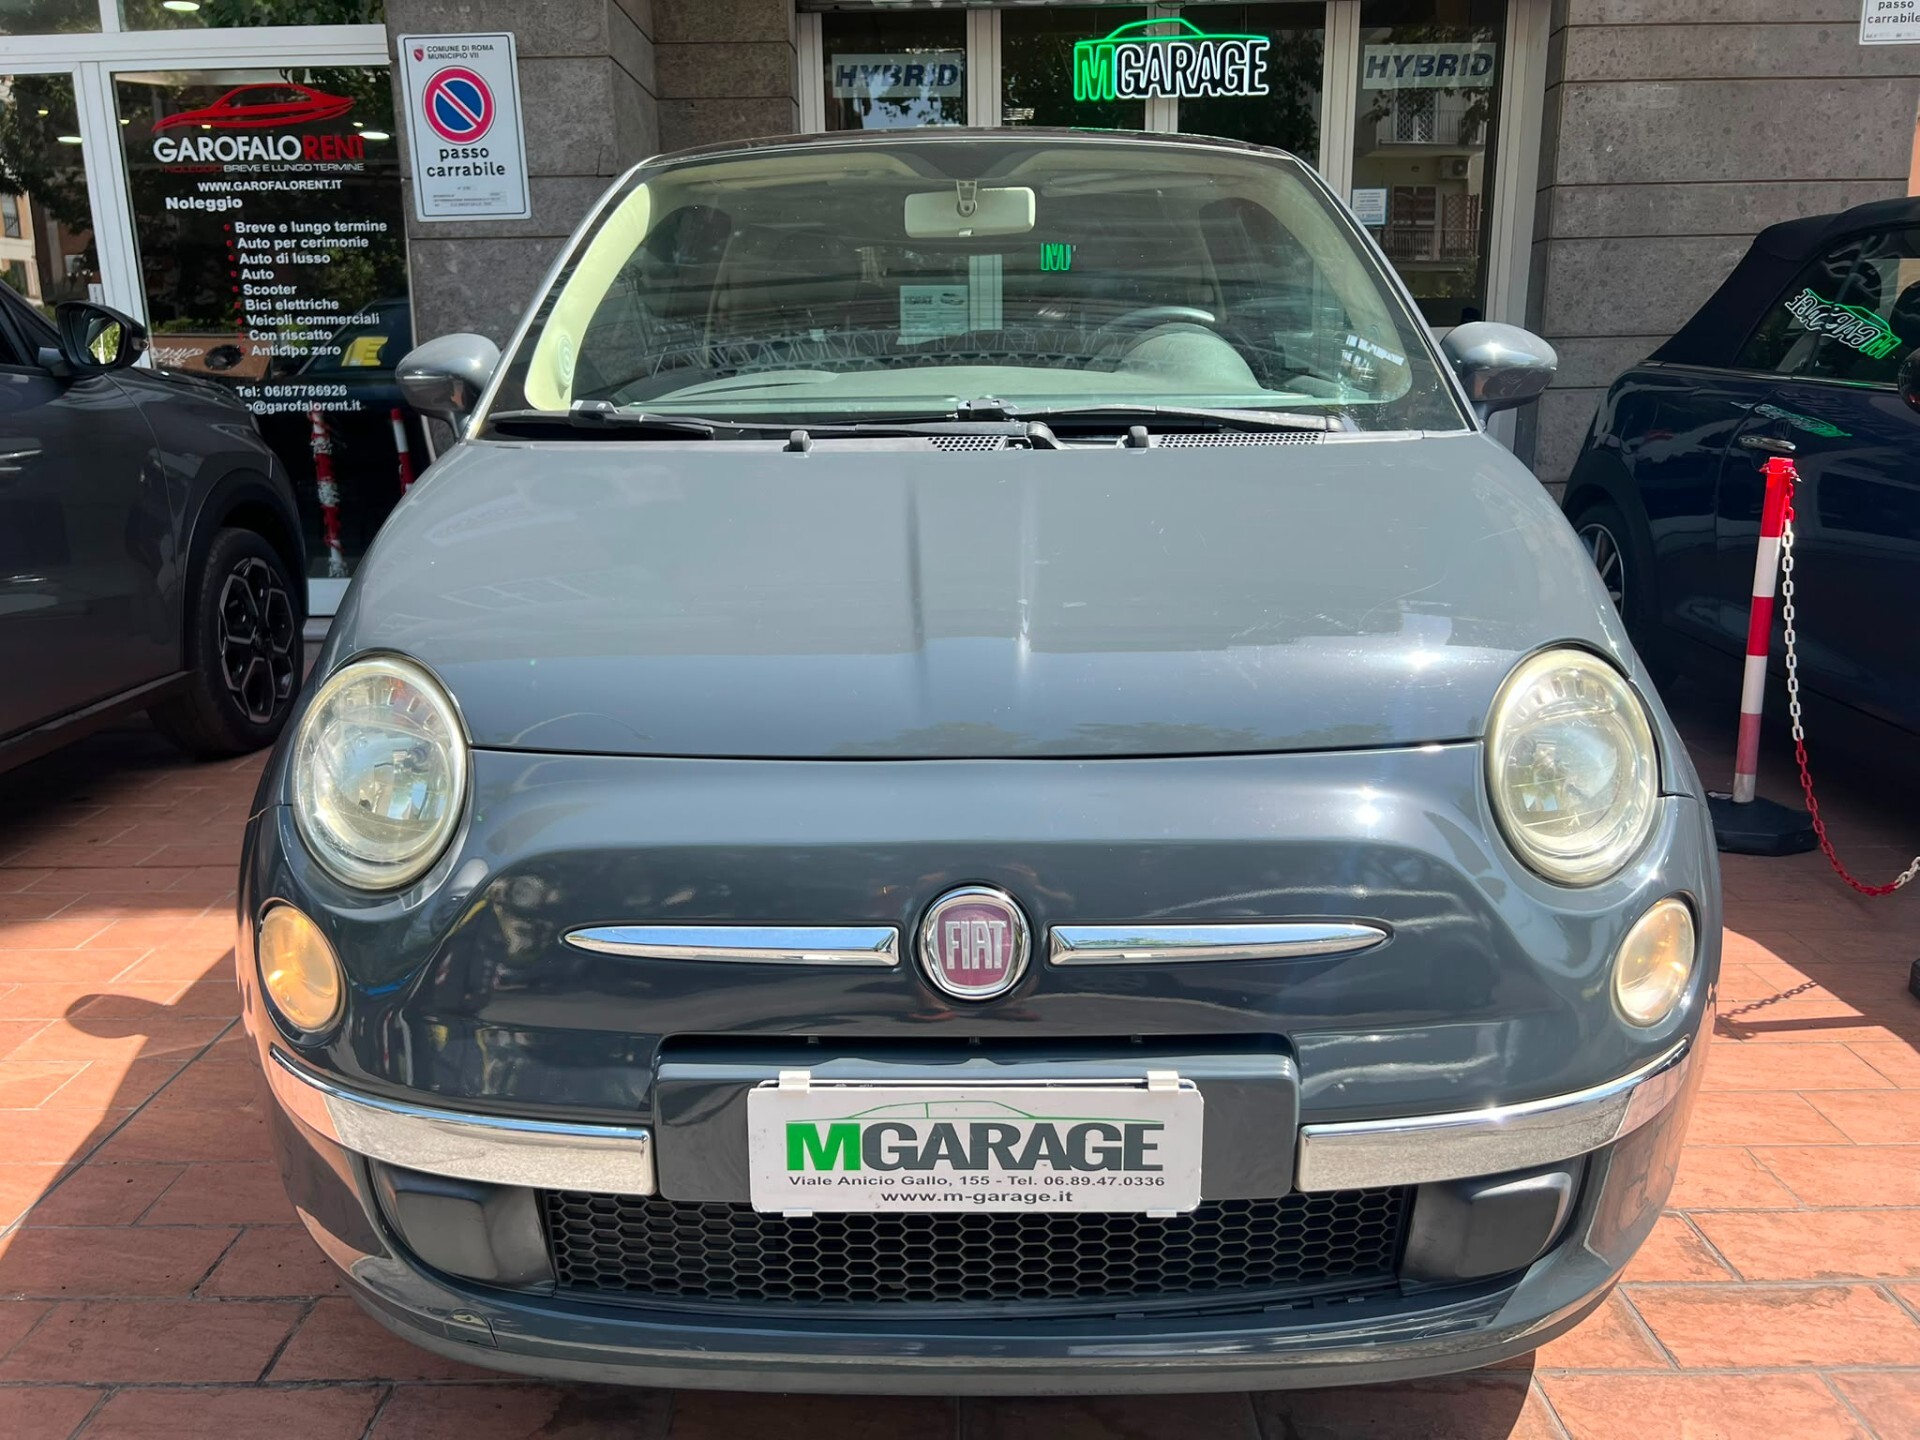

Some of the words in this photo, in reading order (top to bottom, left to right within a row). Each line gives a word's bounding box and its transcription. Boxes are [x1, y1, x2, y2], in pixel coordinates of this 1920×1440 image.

[1878, 0, 1915, 11] passo
[1867, 12, 1920, 24] carrabile
[472, 44, 495, 52] ROMA
[427, 52, 468, 60] MUNICIPIO
[1073, 39, 1270, 101] MGARAGE
[1365, 53, 1494, 79] HYBRID
[835, 63, 959, 88] HYBRID
[439, 147, 490, 162] passo
[223, 164, 262, 173] BREVE
[262, 164, 270, 172] E
[271, 163, 313, 172] LUNGO
[313, 163, 365, 172] TERMINE
[426, 162, 506, 178] carrabile
[197, 180, 343, 192] WWW.GAROFALORENT.IT
[165, 197, 243, 212] Noleggio
[235, 221, 276, 234] Breve
[279, 225, 288, 233] e
[291, 221, 331, 235] lungo
[334, 220, 388, 232] termine
[237, 237, 271, 249] Auto
[274, 240, 297, 250] per
[300, 236, 369, 248] cerimonie
[239, 253, 273, 264] Auto
[276, 253, 289, 264] di
[292, 252, 331, 264] lusso
[241, 269, 275, 280] Auto
[243, 284, 298, 296] Scooter
[245, 300, 273, 311] Bici
[275, 299, 340, 311] elettriche
[246, 315, 293, 326] Veicoli
[296, 313, 380, 325] commerciali
[249, 331, 277, 342] Con
[280, 330, 333, 341] riscatto
[251, 345, 308, 358] Anticipo
[311, 347, 342, 357] zero
[236, 386, 261, 398] Tel:
[264, 384, 348, 397] 06/87786926
[944, 920, 1008, 970] FIAT
[785, 1121, 1165, 1172] MGARAGE
[789, 1175, 833, 1186] Viale
[837, 1175, 895, 1186] Anicio
[900, 1175, 953, 1188] Gallo,
[959, 1174, 990, 1187] 155
[1007, 1174, 1039, 1187] Tel.
[1043, 1175, 1166, 1187] 06.89.47.0336
[881, 1190, 1073, 1204] www.m-garage.it
